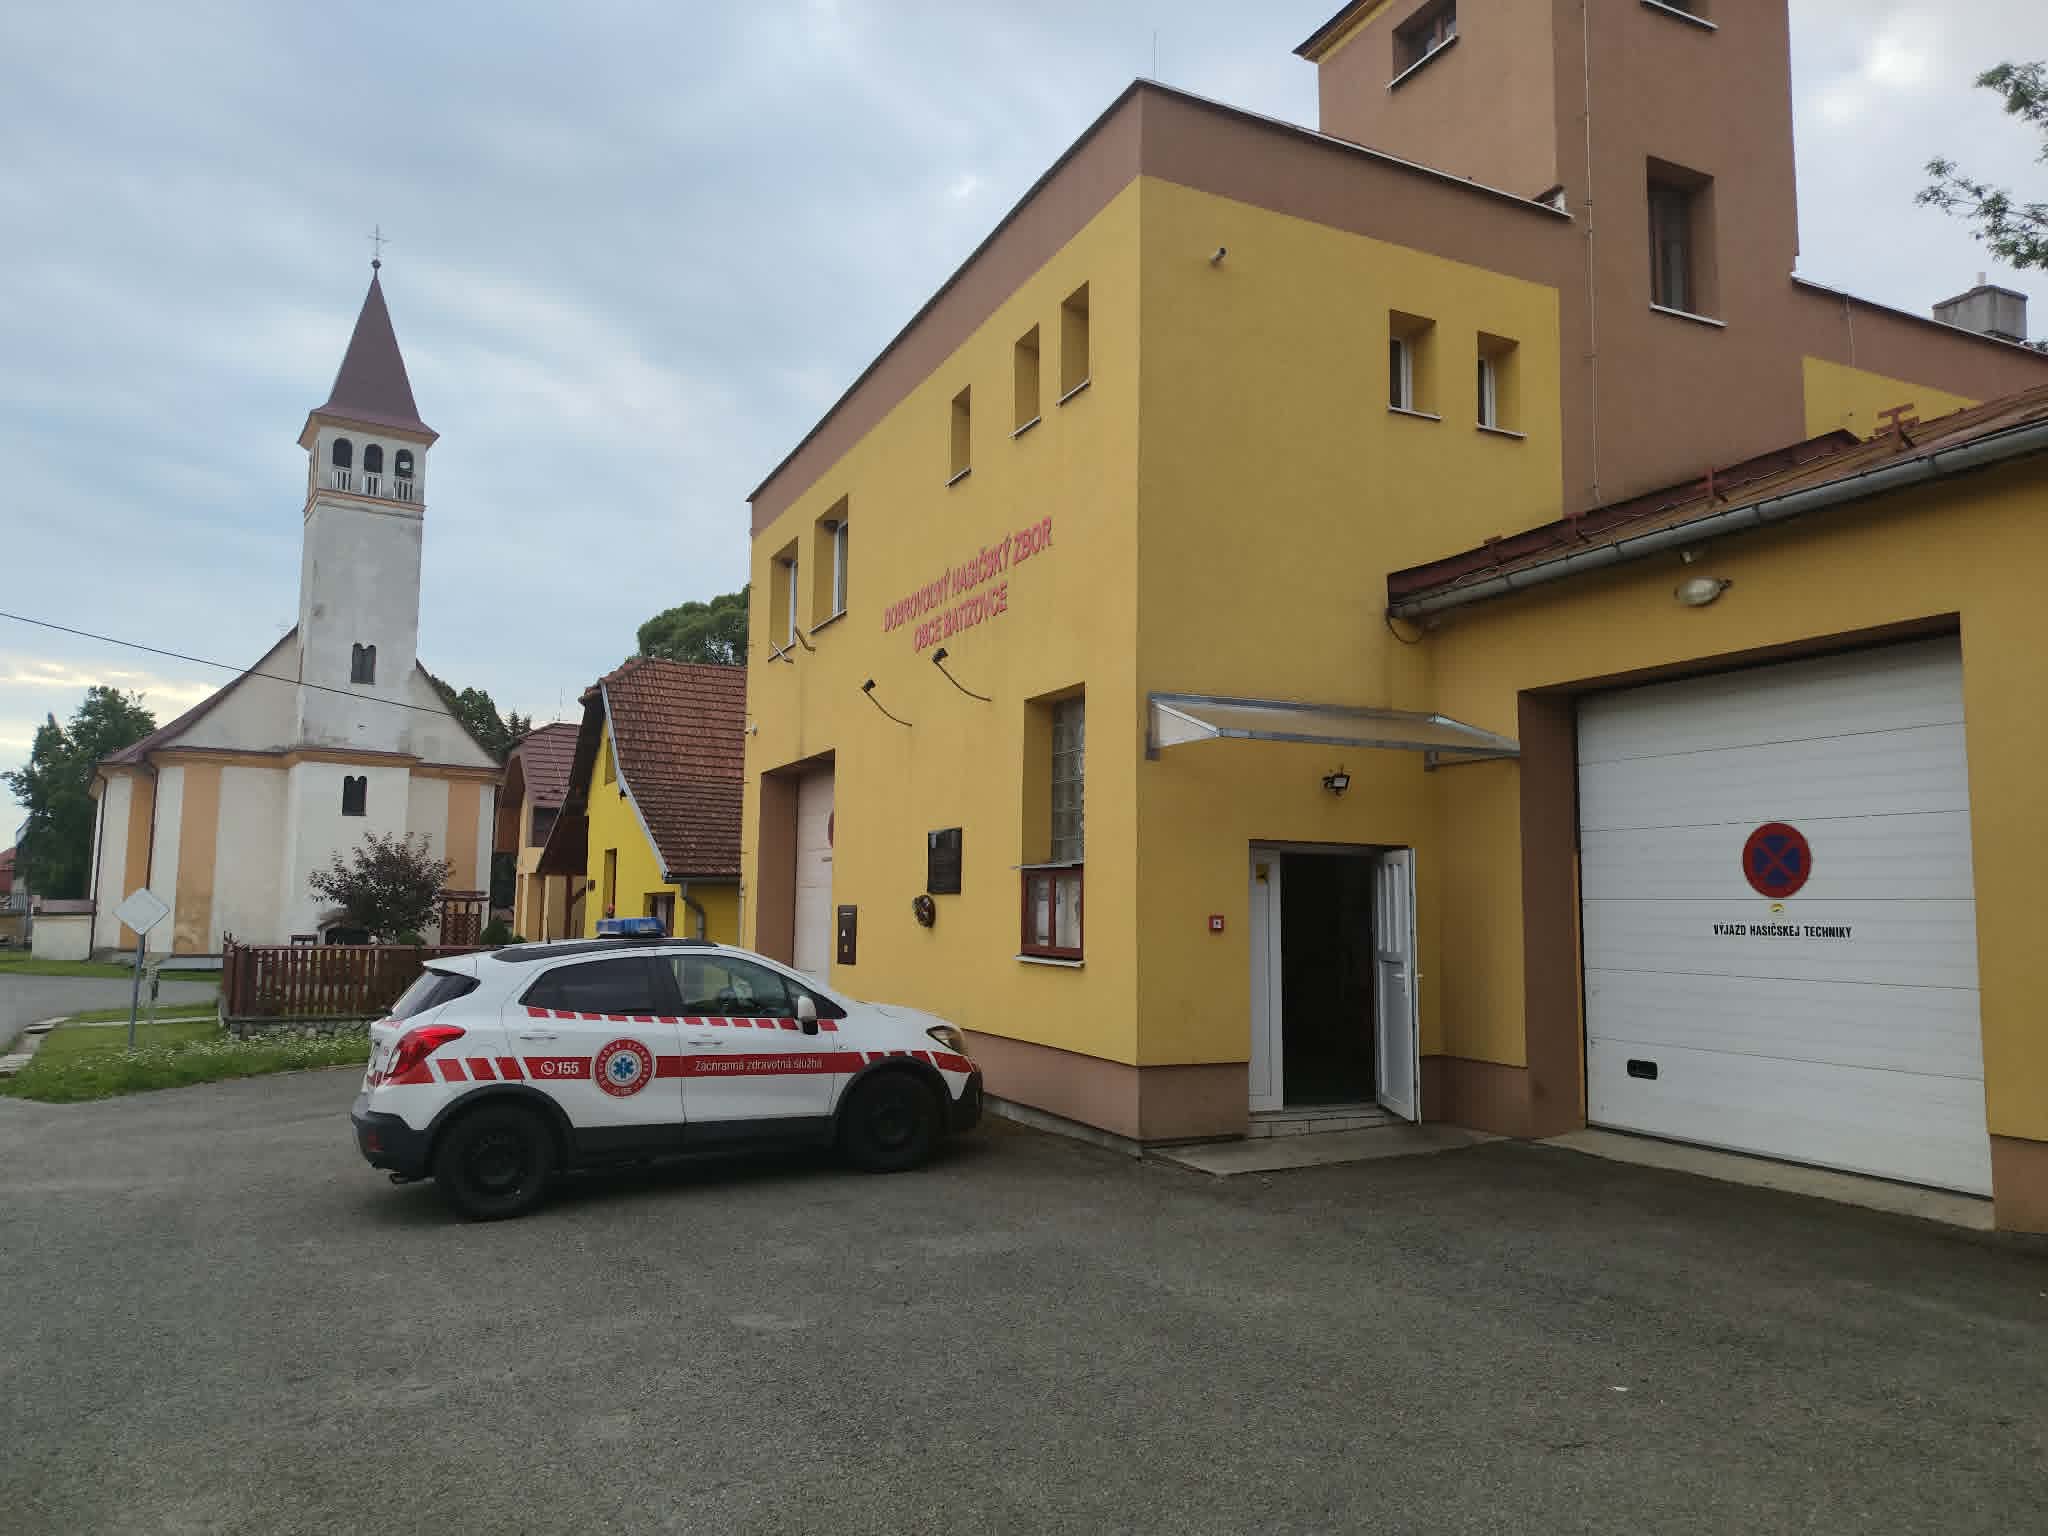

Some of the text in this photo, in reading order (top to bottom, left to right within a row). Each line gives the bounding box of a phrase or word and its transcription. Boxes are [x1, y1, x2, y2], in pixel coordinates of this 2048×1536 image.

[1013, 516, 1052, 566] ZBOR
[914, 581, 1008, 653] OBCE BATIZOVCE
[1750, 922, 1800, 937] HASIČSKEJ
[1804, 926, 1852, 938] TECHNIKY
[557, 1062, 579, 1075] 155
[696, 1057, 822, 1072] Záchranná zdravotná služba
